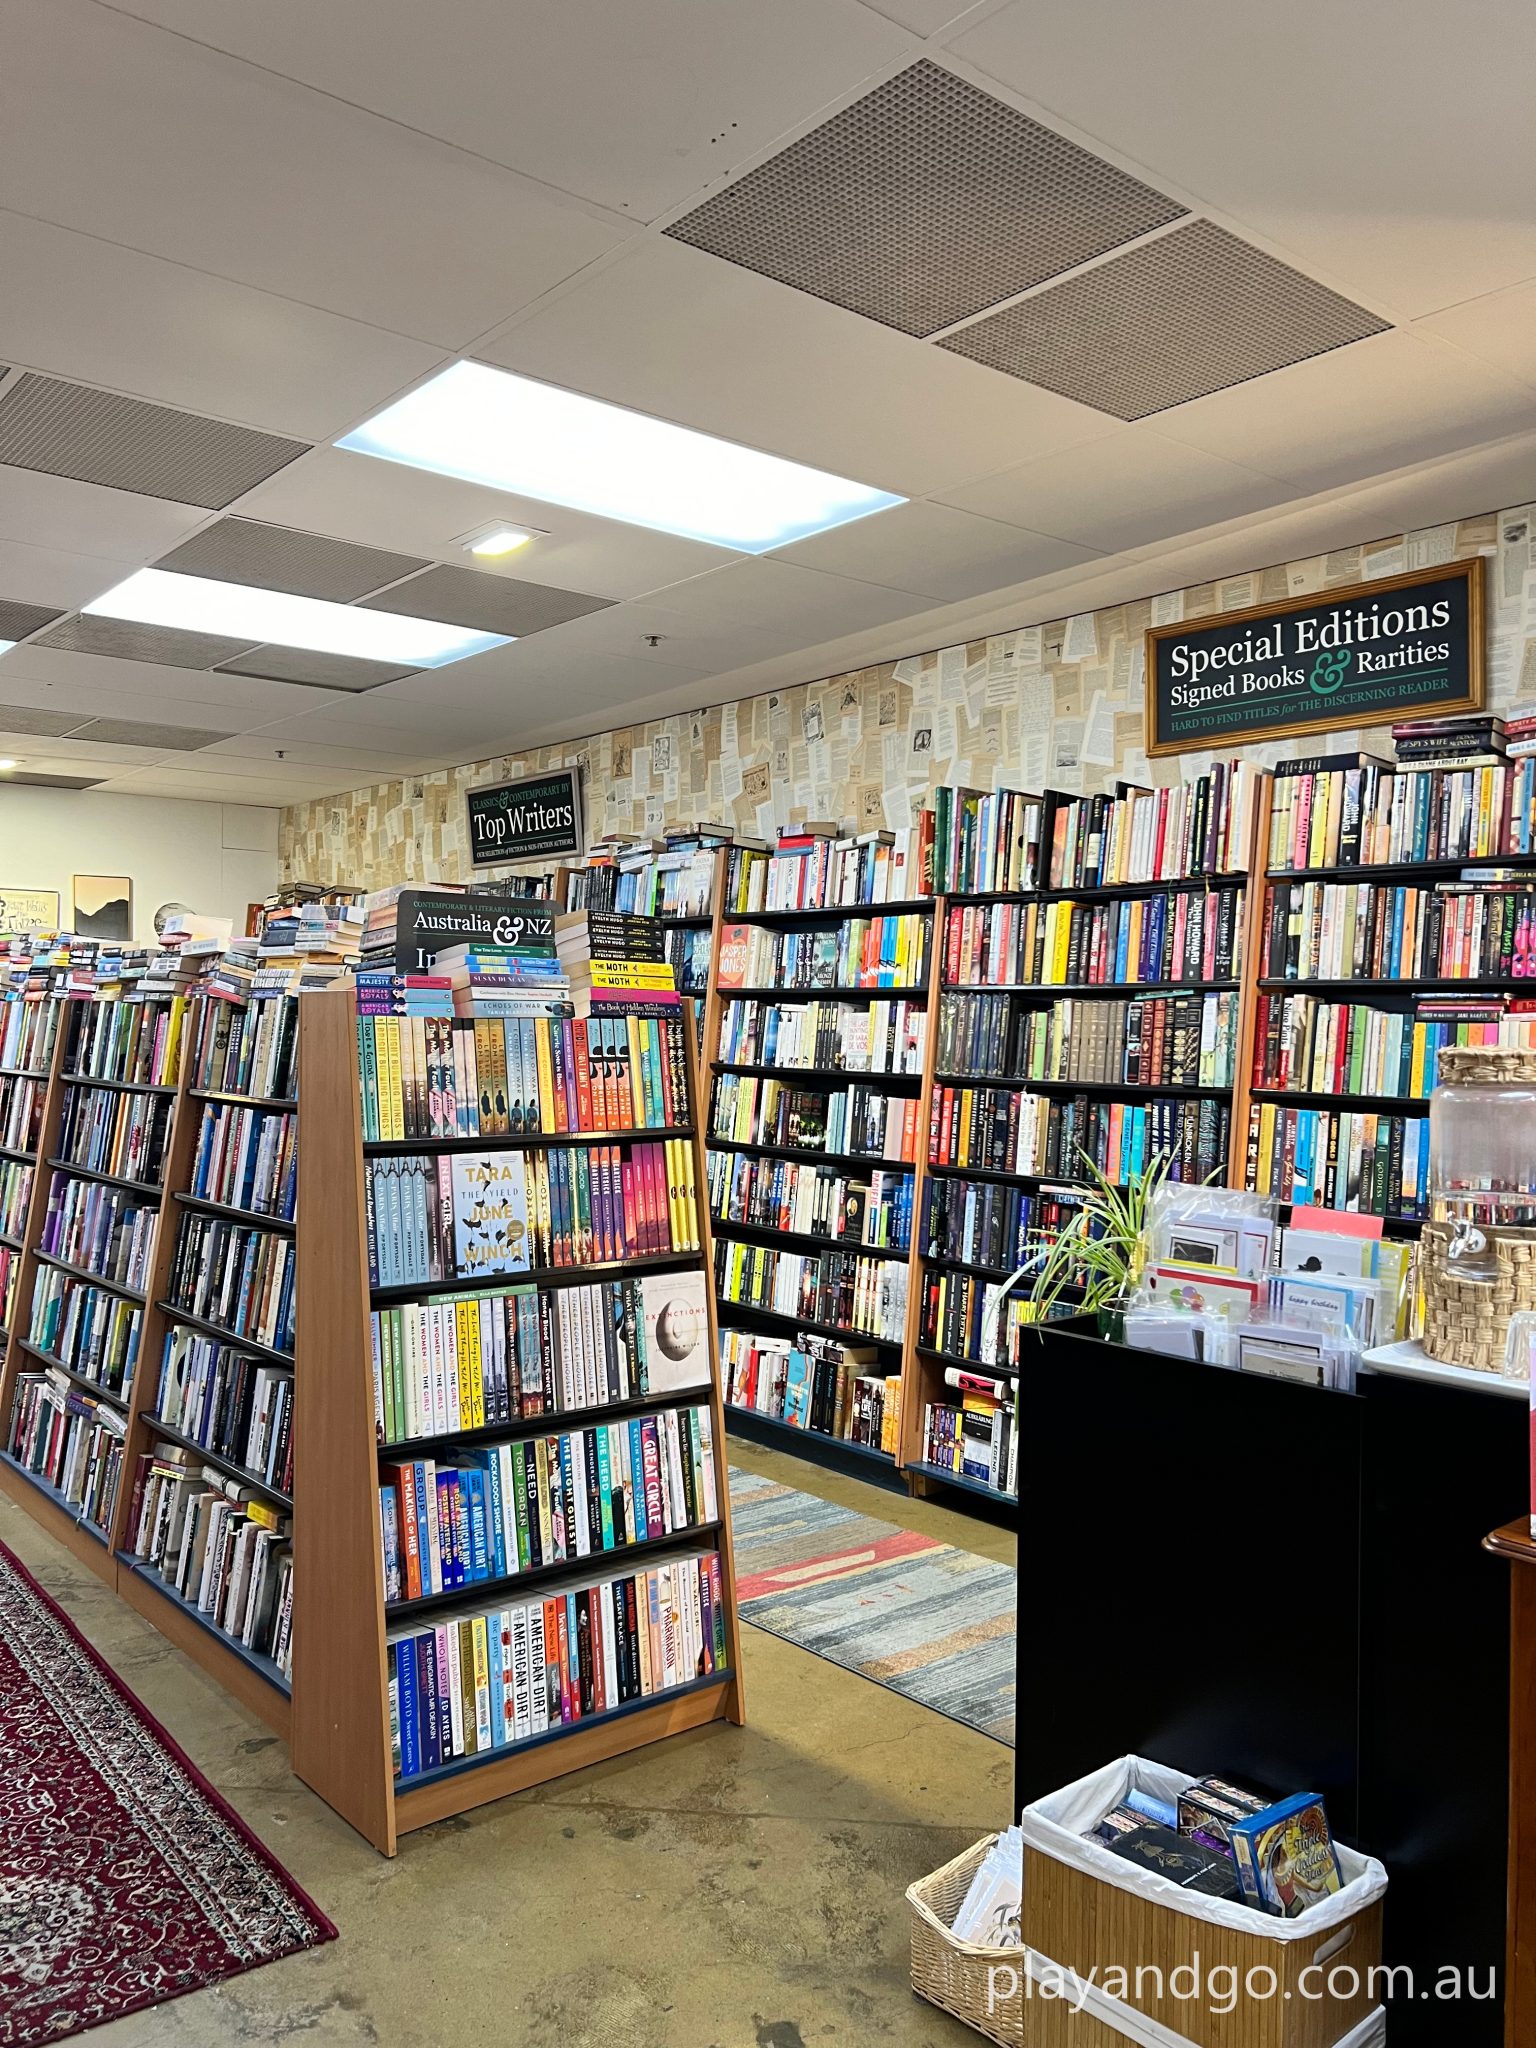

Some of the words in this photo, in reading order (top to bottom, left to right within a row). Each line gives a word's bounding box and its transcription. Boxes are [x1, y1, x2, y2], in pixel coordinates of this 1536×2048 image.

[1171, 624, 1283, 682] Special
[1295, 600, 1450, 654] Editions
[1170, 675, 1235, 708] Signed
[1242, 666, 1305, 693] Books
[1309, 649, 1351, 694] &
[1357, 641, 1449, 674] Rarities
[1171, 718, 1199, 731] HARD
[1200, 716, 1215, 727] TO
[1216, 712, 1242, 725] FIND
[1243, 705, 1280, 720] TITLES
[1280, 702, 1297, 717] for
[1298, 698, 1322, 712] THE
[1324, 686, 1396, 709] DISCERNING
[1399, 679, 1449, 698] READER
[472, 796, 499, 810] CLASSICS
[499, 791, 509, 810] &
[509, 784, 561, 803] CONTEMPORARY
[561, 782, 571, 793] BY
[474, 813, 506, 845] Top
[506, 802, 573, 835] Writers
[1351, 803, 1359, 824] JOHN
[413, 900, 468, 911] CONTEMPORARY
[475, 905, 507, 914] LITERARY
[507, 906, 533, 915] FICTION
[533, 908, 552, 916] FROM
[1193, 898, 1202, 921] JOHN
[413, 911, 492, 932] Australia
[493, 915, 524, 946] &
[526, 919, 552, 935] NZ
[720, 945, 746, 957] JASPER
[1069, 940, 1078, 968] YORK
[1190, 924, 1202, 965] HOWARD
[606, 963, 628, 971] MOTH
[719, 959, 746, 973] JONES
[608, 978, 630, 986] MOTH
[1284, 1003, 1292, 1024] Nine
[378, 1027, 386, 1056] BRIGHT
[390, 1027, 398, 1056] BRIGHT
[379, 1060, 388, 1096] BURNING
[391, 1060, 401, 1096] BURNING
[431, 1071, 439, 1090] Fault
[381, 1099, 390, 1129] THINGS
[394, 1098, 402, 1128] THINGS
[1184, 1116, 1194, 1163] UNBROKEN
[465, 1166, 512, 1182] TARA
[1376, 1161, 1384, 1198] GODDESS
[461, 1191, 480, 1199] THE
[489, 1189, 519, 1197] YIELD
[871, 1173, 880, 1205] PACIFIC
[471, 1204, 513, 1221] JUNE
[463, 1243, 522, 1261] WINCH
[1289, 1296, 1308, 1305] happy
[1311, 1299, 1338, 1310] birthday
[598, 1433, 606, 1454] THE
[516, 1450, 524, 1476] TONI
[643, 1440, 657, 1478] GREAT
[416, 1468, 425, 1511] GROUP
[490, 1453, 500, 1506] ROCKADOON
[527, 1464, 536, 1499] NEED
[565, 1462, 574, 1503] NIGHT
[600, 1459, 609, 1491] HERD
[405, 1483, 415, 1523] MAKING
[517, 1482, 526, 1527] JORDAN
[645, 1482, 660, 1524] CIRCLE
[443, 1514, 452, 1565] WATERLAND
[473, 1506, 484, 1549] AMERICAN
[567, 1505, 576, 1546] GUEST
[408, 1536, 417, 1556] HER
[475, 1550, 486, 1569] DIRT
[492, 1620, 500, 1634] the
[662, 1607, 675, 1669] PHARMAKON
[438, 1634, 446, 1663] WHOLE
[493, 1636, 501, 1659] party
[531, 1618, 544, 1683] AMERICAN
[402, 1645, 411, 1686] WILLIAM
[426, 1657, 434, 1697] ENIGMATIC
[428, 1699, 435, 1711] MR
[442, 1700, 448, 1710] ED
[533, 1687, 546, 1714] DIRT
[442, 1715, 450, 1740] AYRES
